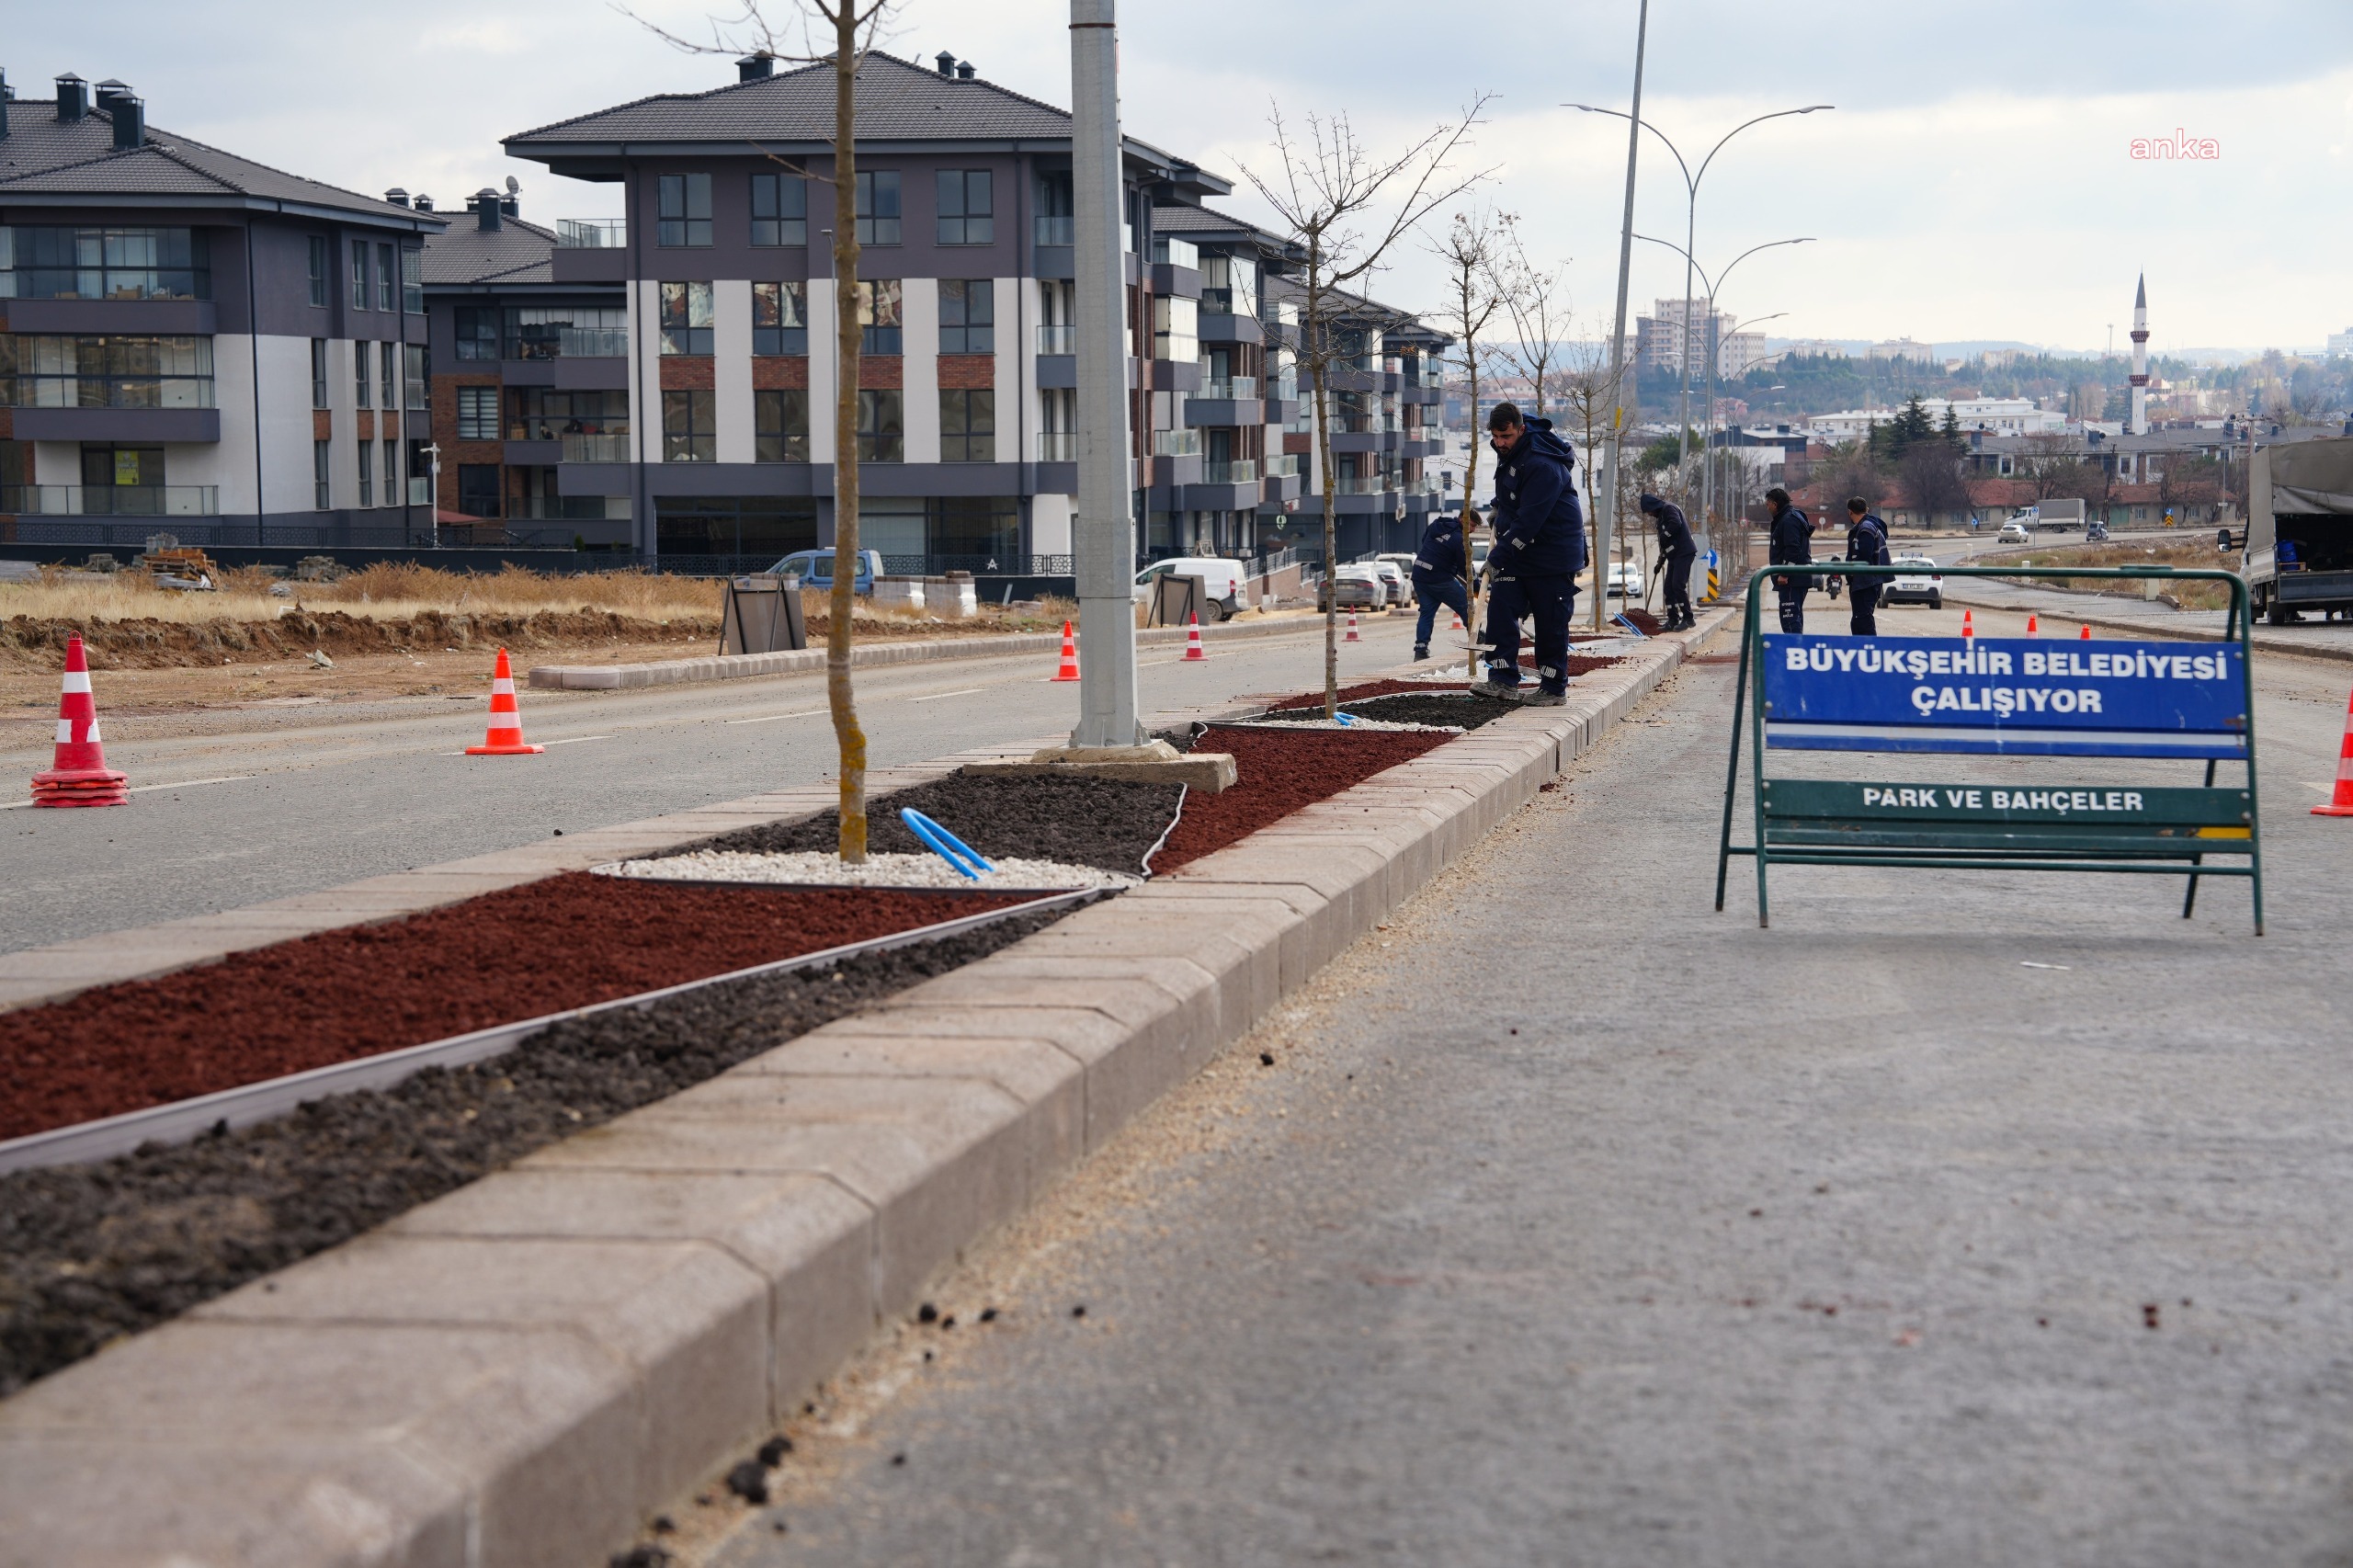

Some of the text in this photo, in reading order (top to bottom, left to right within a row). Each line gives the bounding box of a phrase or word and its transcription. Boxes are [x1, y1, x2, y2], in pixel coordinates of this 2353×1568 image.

[1786, 642, 2227, 680] BÜYÜKŞEHİR BELEDİYESİ
[1911, 686, 2103, 718] ÇALIŞIYOR
[1863, 788, 2143, 815] PARK VE BAHÇELER
